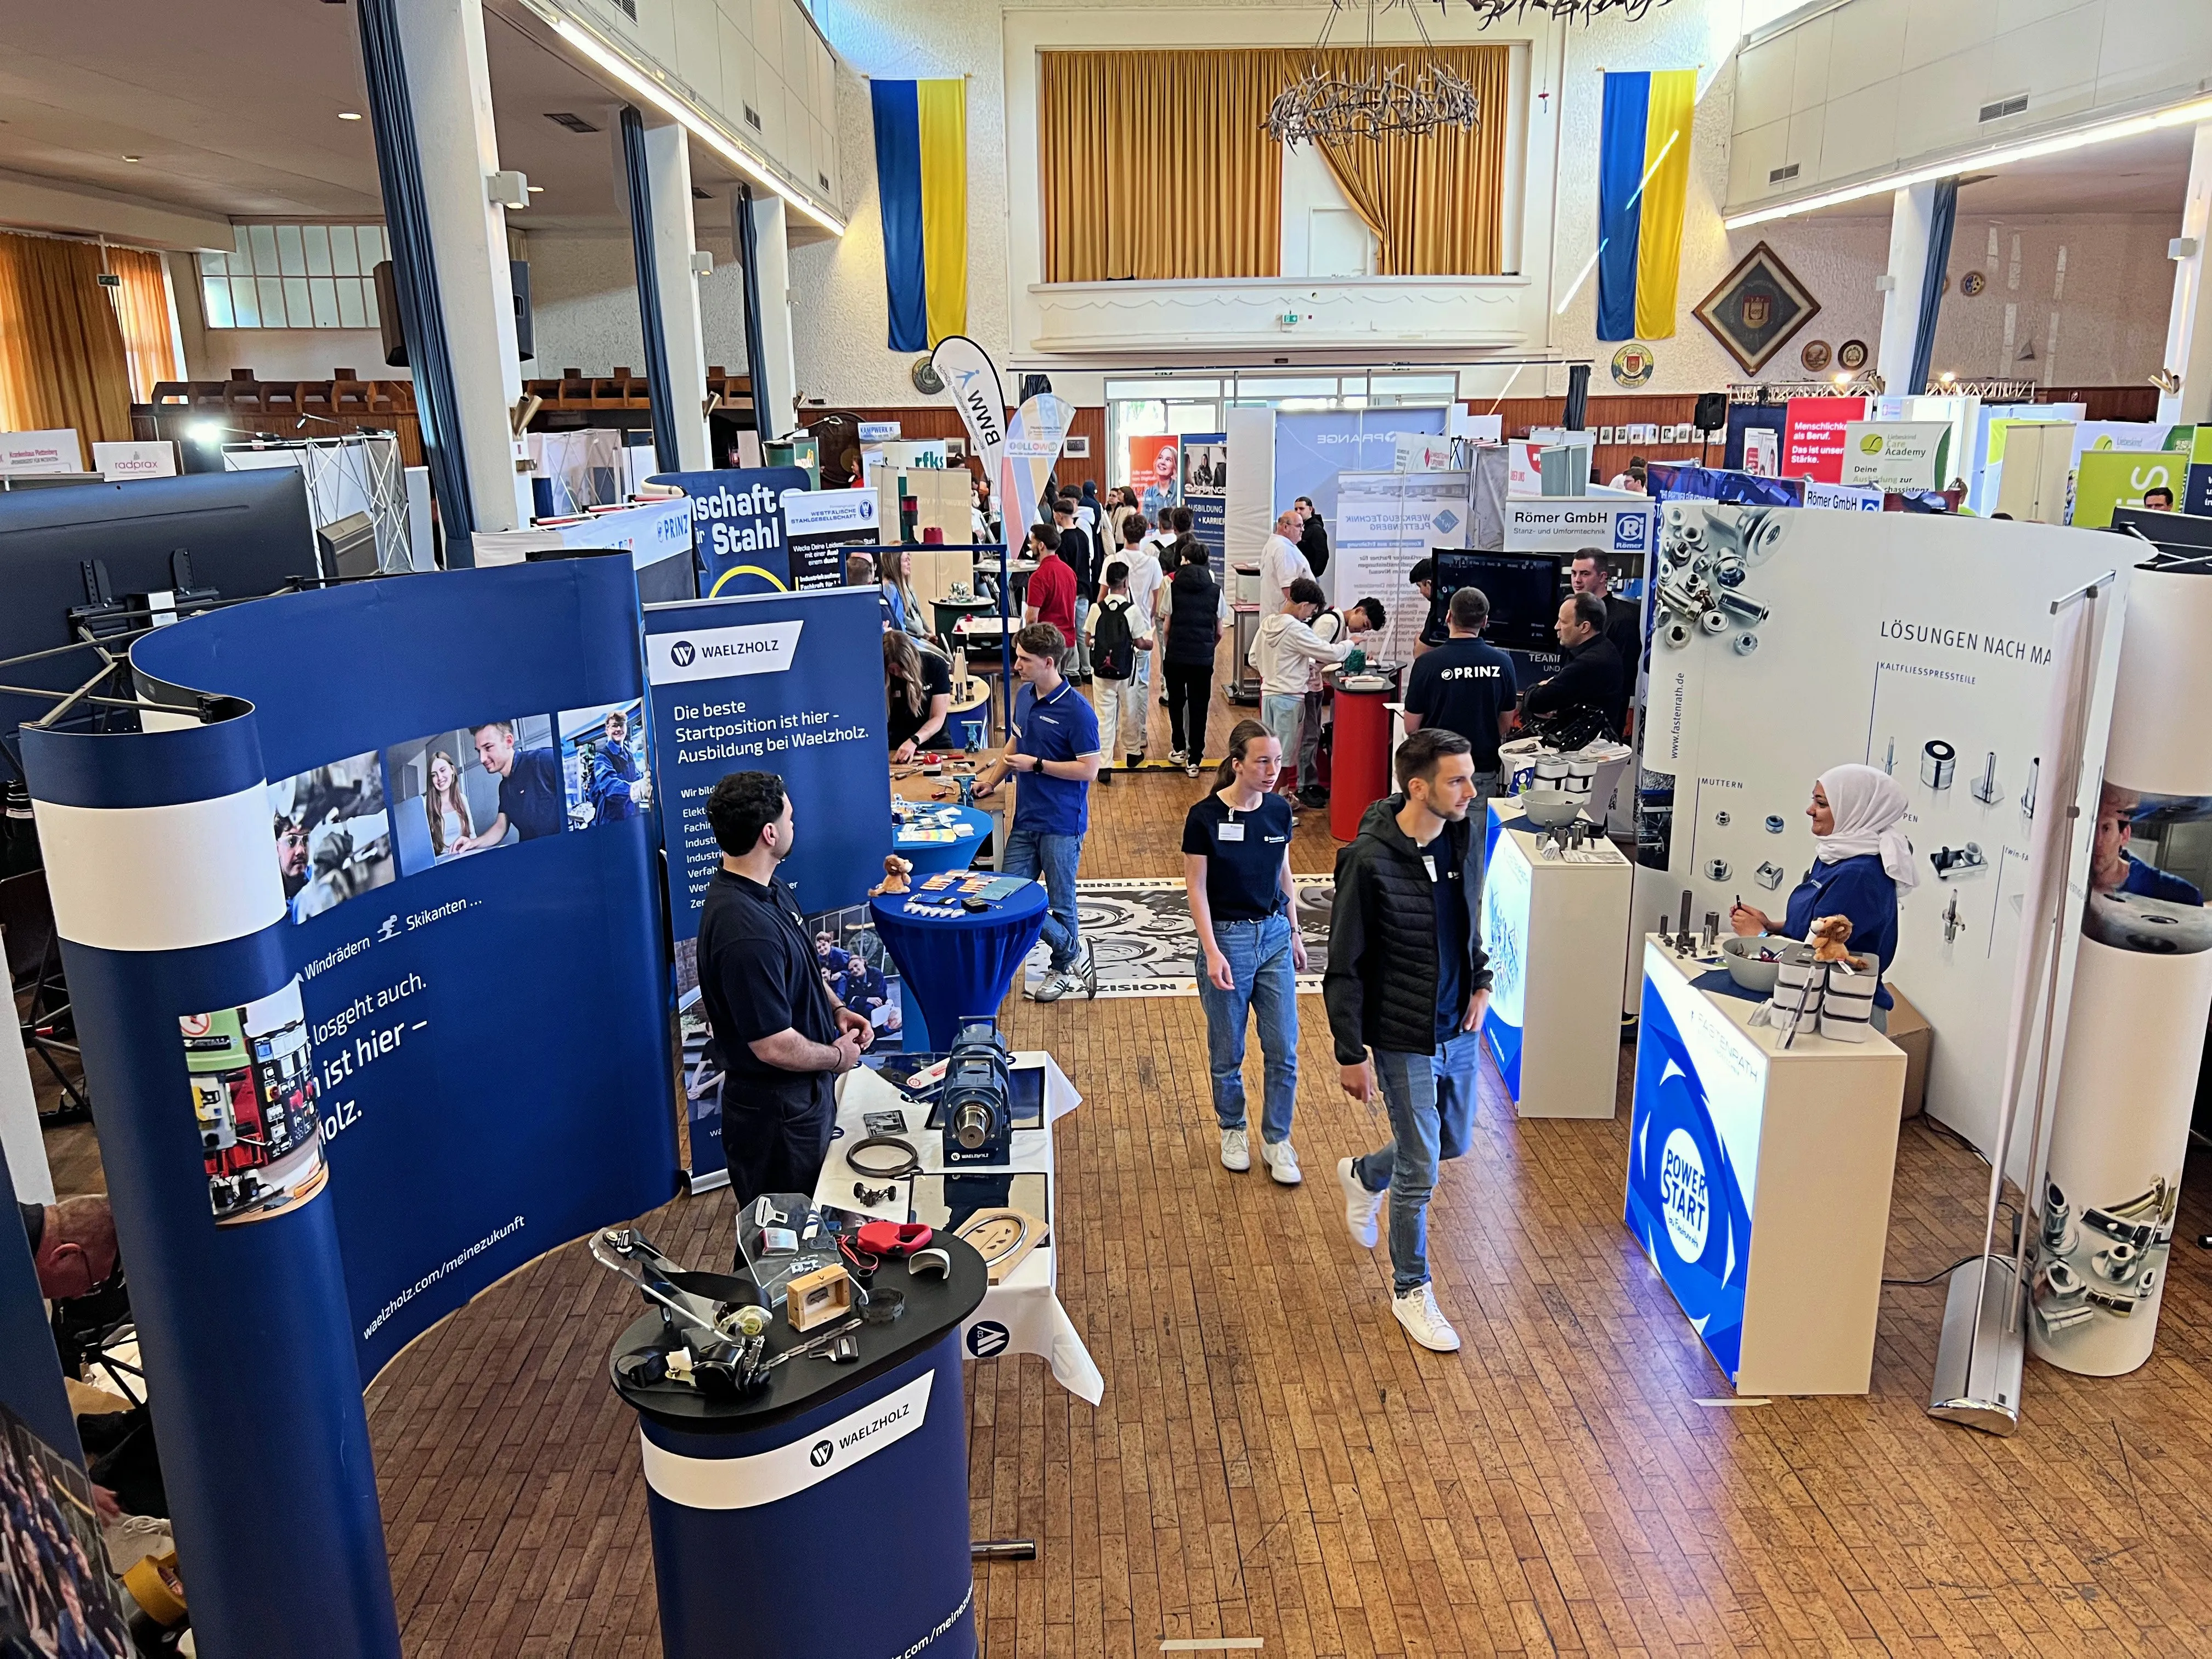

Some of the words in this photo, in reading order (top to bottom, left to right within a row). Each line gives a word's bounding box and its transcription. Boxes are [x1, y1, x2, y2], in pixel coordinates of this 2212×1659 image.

[1793, 432, 1805, 440] als
[1806, 432, 1831, 441] Beruf.
[915, 451, 944, 467] rfks
[1791, 455, 1819, 464] Stärke.
[1792, 445, 1808, 454] Das
[1808, 445, 1819, 454] ist
[1884, 448, 1926, 458] Academy
[115, 461, 159, 470] radprax
[1807, 491, 1831, 507] Römer
[1833, 494, 1858, 511] GmbH
[664, 514, 688, 540] PRINZ
[1515, 511, 1560, 523] Römer
[1565, 512, 1607, 523] GmbH
[712, 517, 780, 555] Stahl
[702, 640, 779, 658] WAELZHOLZ
[1881, 619, 1978, 650] LÖSUNGEN
[1984, 636, 2026, 660] NACH
[1454, 665, 1500, 680] PRINZ
[1880, 662, 1976, 685] KALTFLIESSPRESSTEILE
[674, 706, 699, 721] Die
[703, 700, 746, 716] beste
[1671, 673, 1684, 759] www.fastenrath.de
[675, 719, 777, 743] Startposition
[780, 714, 798, 729] ist
[802, 710, 830, 726] hier
[678, 741, 764, 764] Ausbildung
[766, 735, 789, 752] bei
[791, 726, 870, 748] Waelzholz.
[681, 788, 697, 798] Wir
[1701, 777, 1743, 789] MUTTERN
[682, 806, 706, 818] Elekt
[690, 899, 706, 909] Zer
[304, 937, 370, 980] Windrädern
[406, 898, 467, 932] Skikanten
[312, 995, 374, 1046] losgeht
[377, 972, 427, 1008] auch.
[323, 1049, 353, 1090] ist
[357, 1022, 405, 1067] hier
[1666, 1148, 1706, 1201] POWER
[1662, 1168, 1706, 1232] START
[364, 1215, 525, 1340] waelzholz.com/meinezukunft
[839, 1403, 910, 1450] WAELZHOLZ
